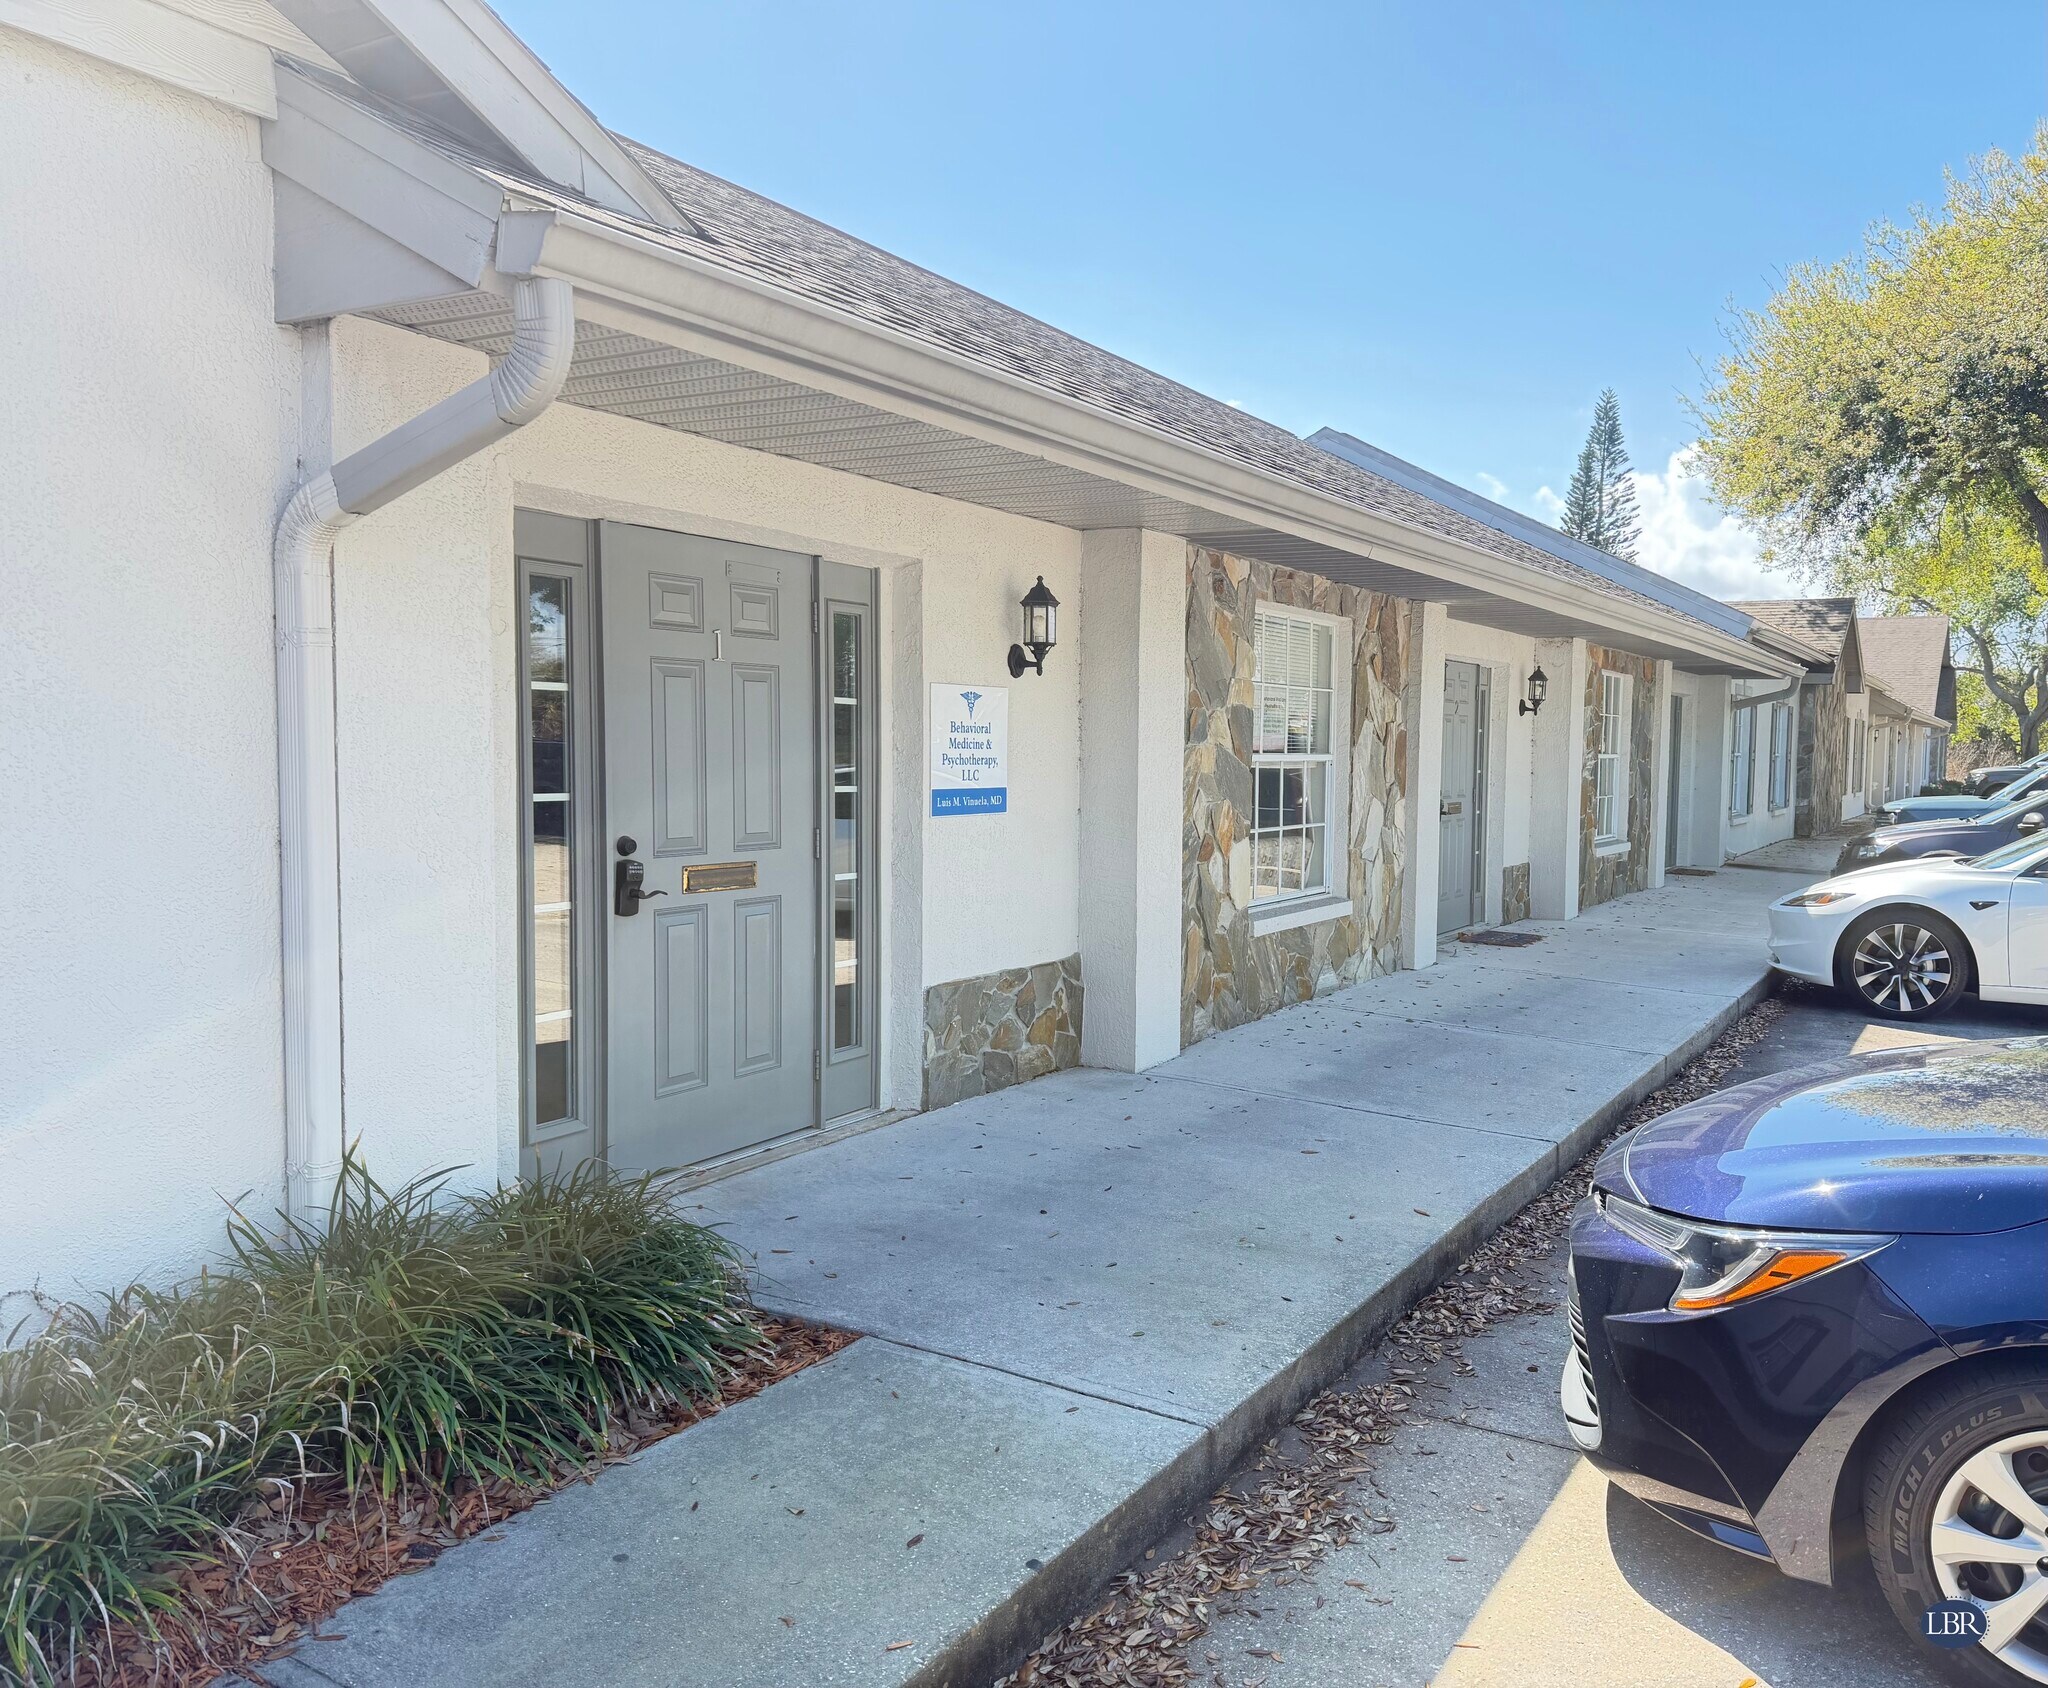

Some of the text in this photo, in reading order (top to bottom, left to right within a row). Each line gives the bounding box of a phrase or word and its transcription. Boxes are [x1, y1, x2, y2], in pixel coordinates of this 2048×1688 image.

[712, 629, 725, 662] 1
[950, 720, 991, 734] Behavioral
[948, 737, 993, 750] Medicine &
[942, 753, 998, 769] Psychotherapy,
[962, 769, 980, 781] LLC
[937, 797, 951, 807] Luis
[952, 797, 962, 807] M.
[990, 795, 1003, 805] MD
[1894, 1464, 1923, 1557] MACH
[1940, 1406, 2002, 1448] PLUS
